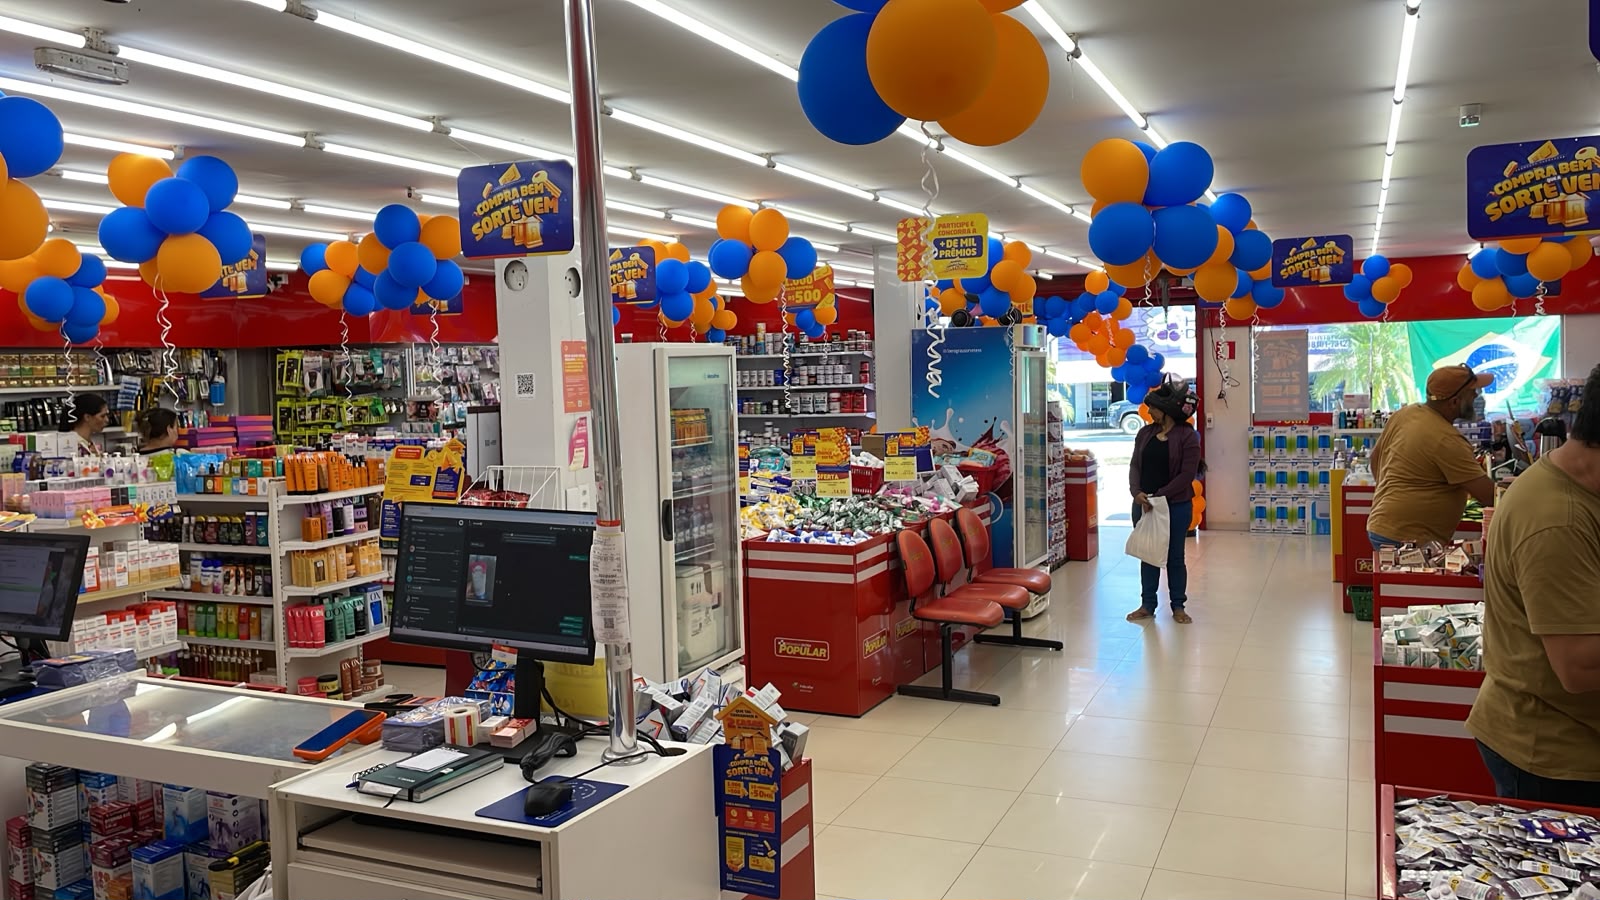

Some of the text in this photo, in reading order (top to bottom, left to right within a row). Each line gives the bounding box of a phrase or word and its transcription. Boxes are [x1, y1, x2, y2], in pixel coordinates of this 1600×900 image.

[1494, 165, 1557, 196] COMPRA
[1558, 159, 1592, 174] BEM
[476, 182, 545, 215] COMPRA BEM
[1485, 182, 1558, 221] SORTE
[471, 196, 559, 241] SORTE VEM
[937, 221, 966, 229] PARTICIPE
[937, 227, 971, 236] CONCORRA
[946, 238, 960, 249] DE
[961, 237, 977, 247] MIL
[939, 247, 977, 258] PRÊMIOS
[1280, 254, 1343, 279] SORTE VEM
[795, 289, 821, 303] 500
[778, 644, 827, 658] POPULAR
[726, 767, 773, 778] SORTE VEM
